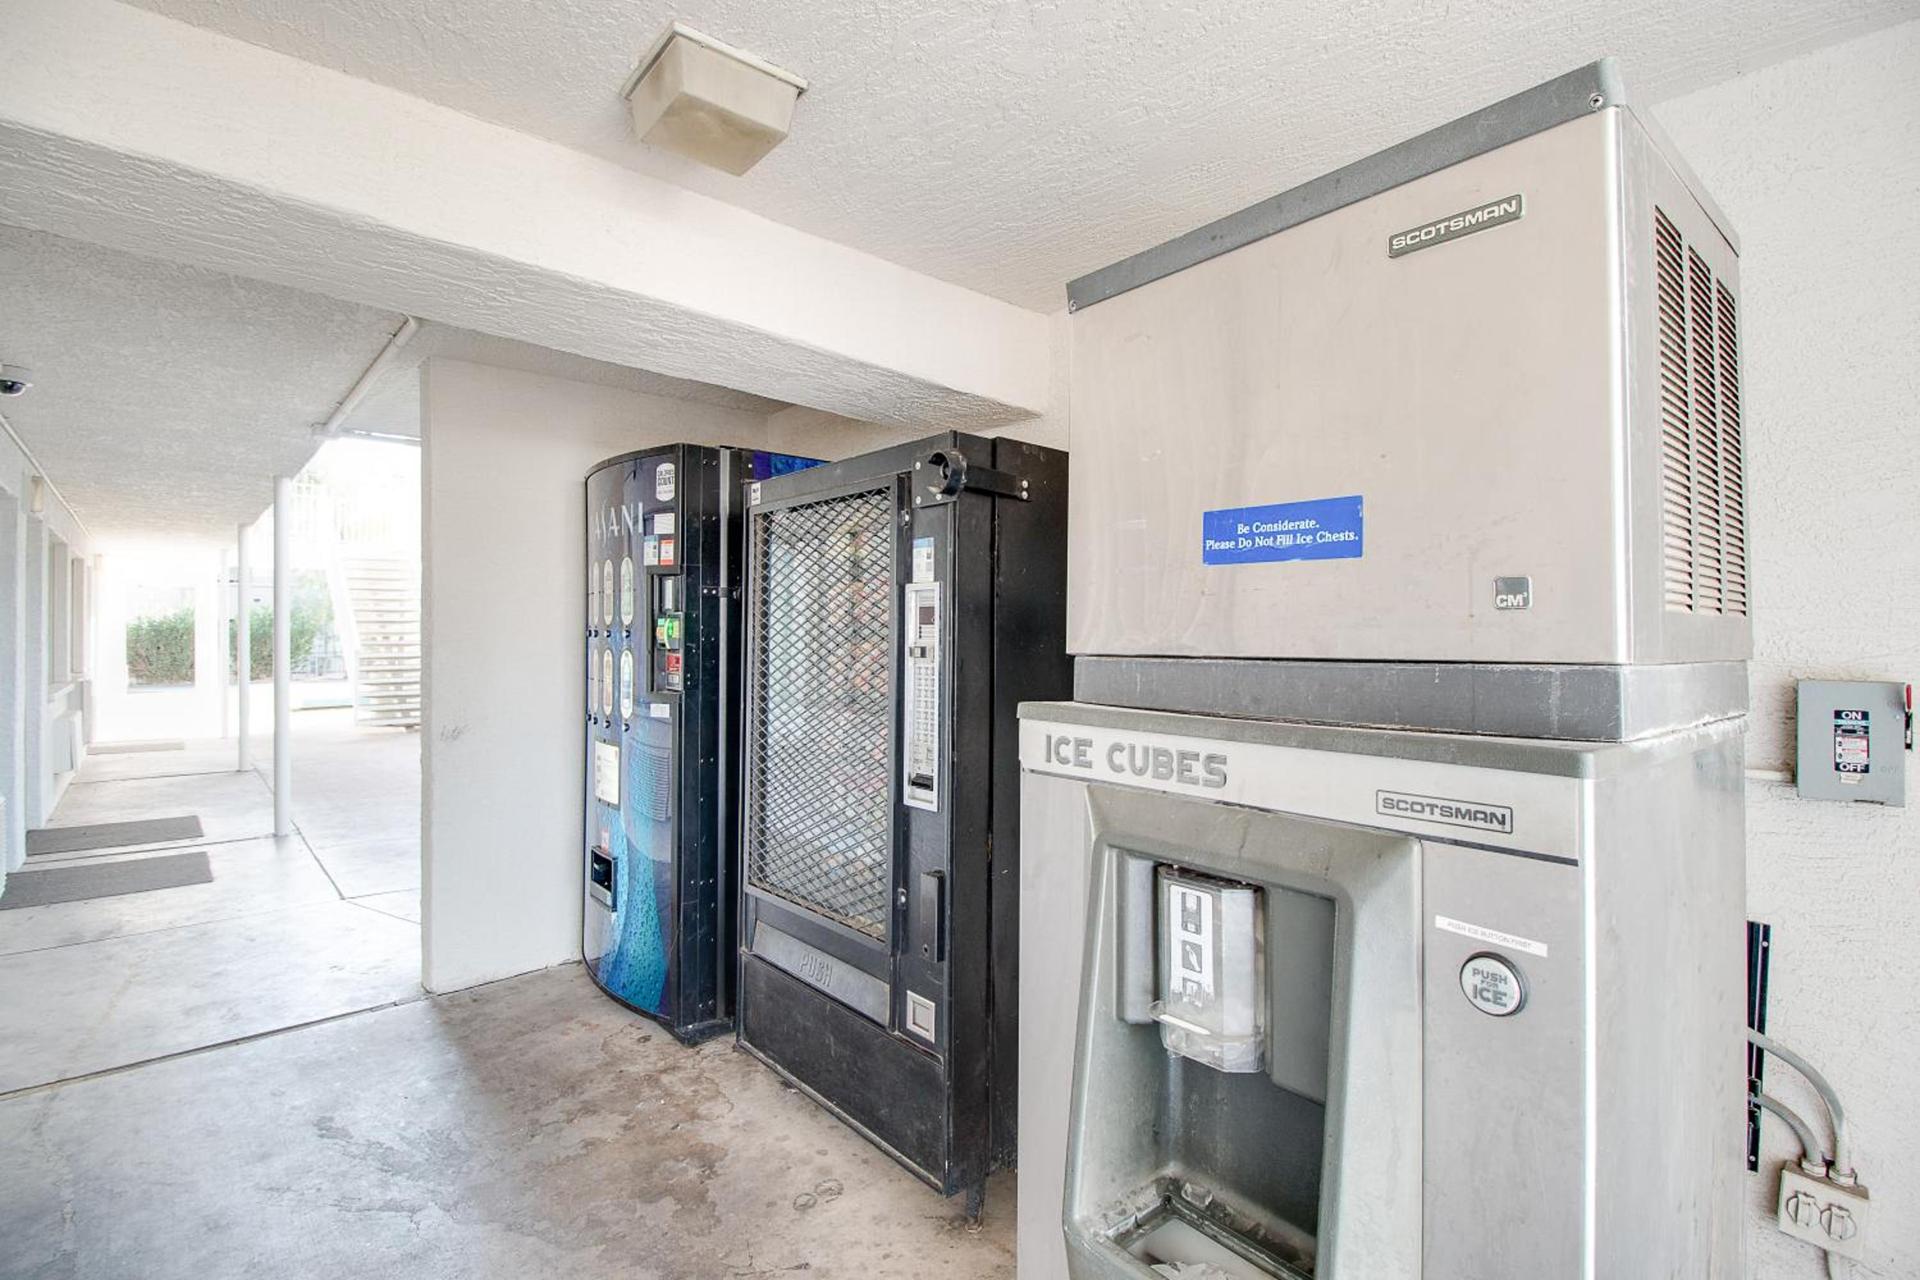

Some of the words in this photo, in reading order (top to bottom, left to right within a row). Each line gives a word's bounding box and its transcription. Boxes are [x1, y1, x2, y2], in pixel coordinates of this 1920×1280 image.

[1392, 199, 1517, 250] SCOTSMAN
[1236, 522, 1250, 535] Be
[1252, 518, 1320, 533] Considerate.
[1205, 538, 1236, 550] Please
[1238, 537, 1253, 549] Do
[1255, 536, 1274, 548] Not
[1276, 533, 1294, 547] Fill
[1296, 533, 1314, 545] Ice
[1316, 530, 1360, 543] Chests.
[1841, 711, 1862, 720] ON
[1045, 734, 1093, 769] ICE
[1106, 742, 1228, 789] CUBES
[1839, 762, 1866, 772] OFF
[1382, 796, 1506, 826] SCOTSMAN
[800, 952, 833, 988] PUSH
[1472, 967, 1508, 985] PUSH
[1472, 984, 1507, 1008] ICE
